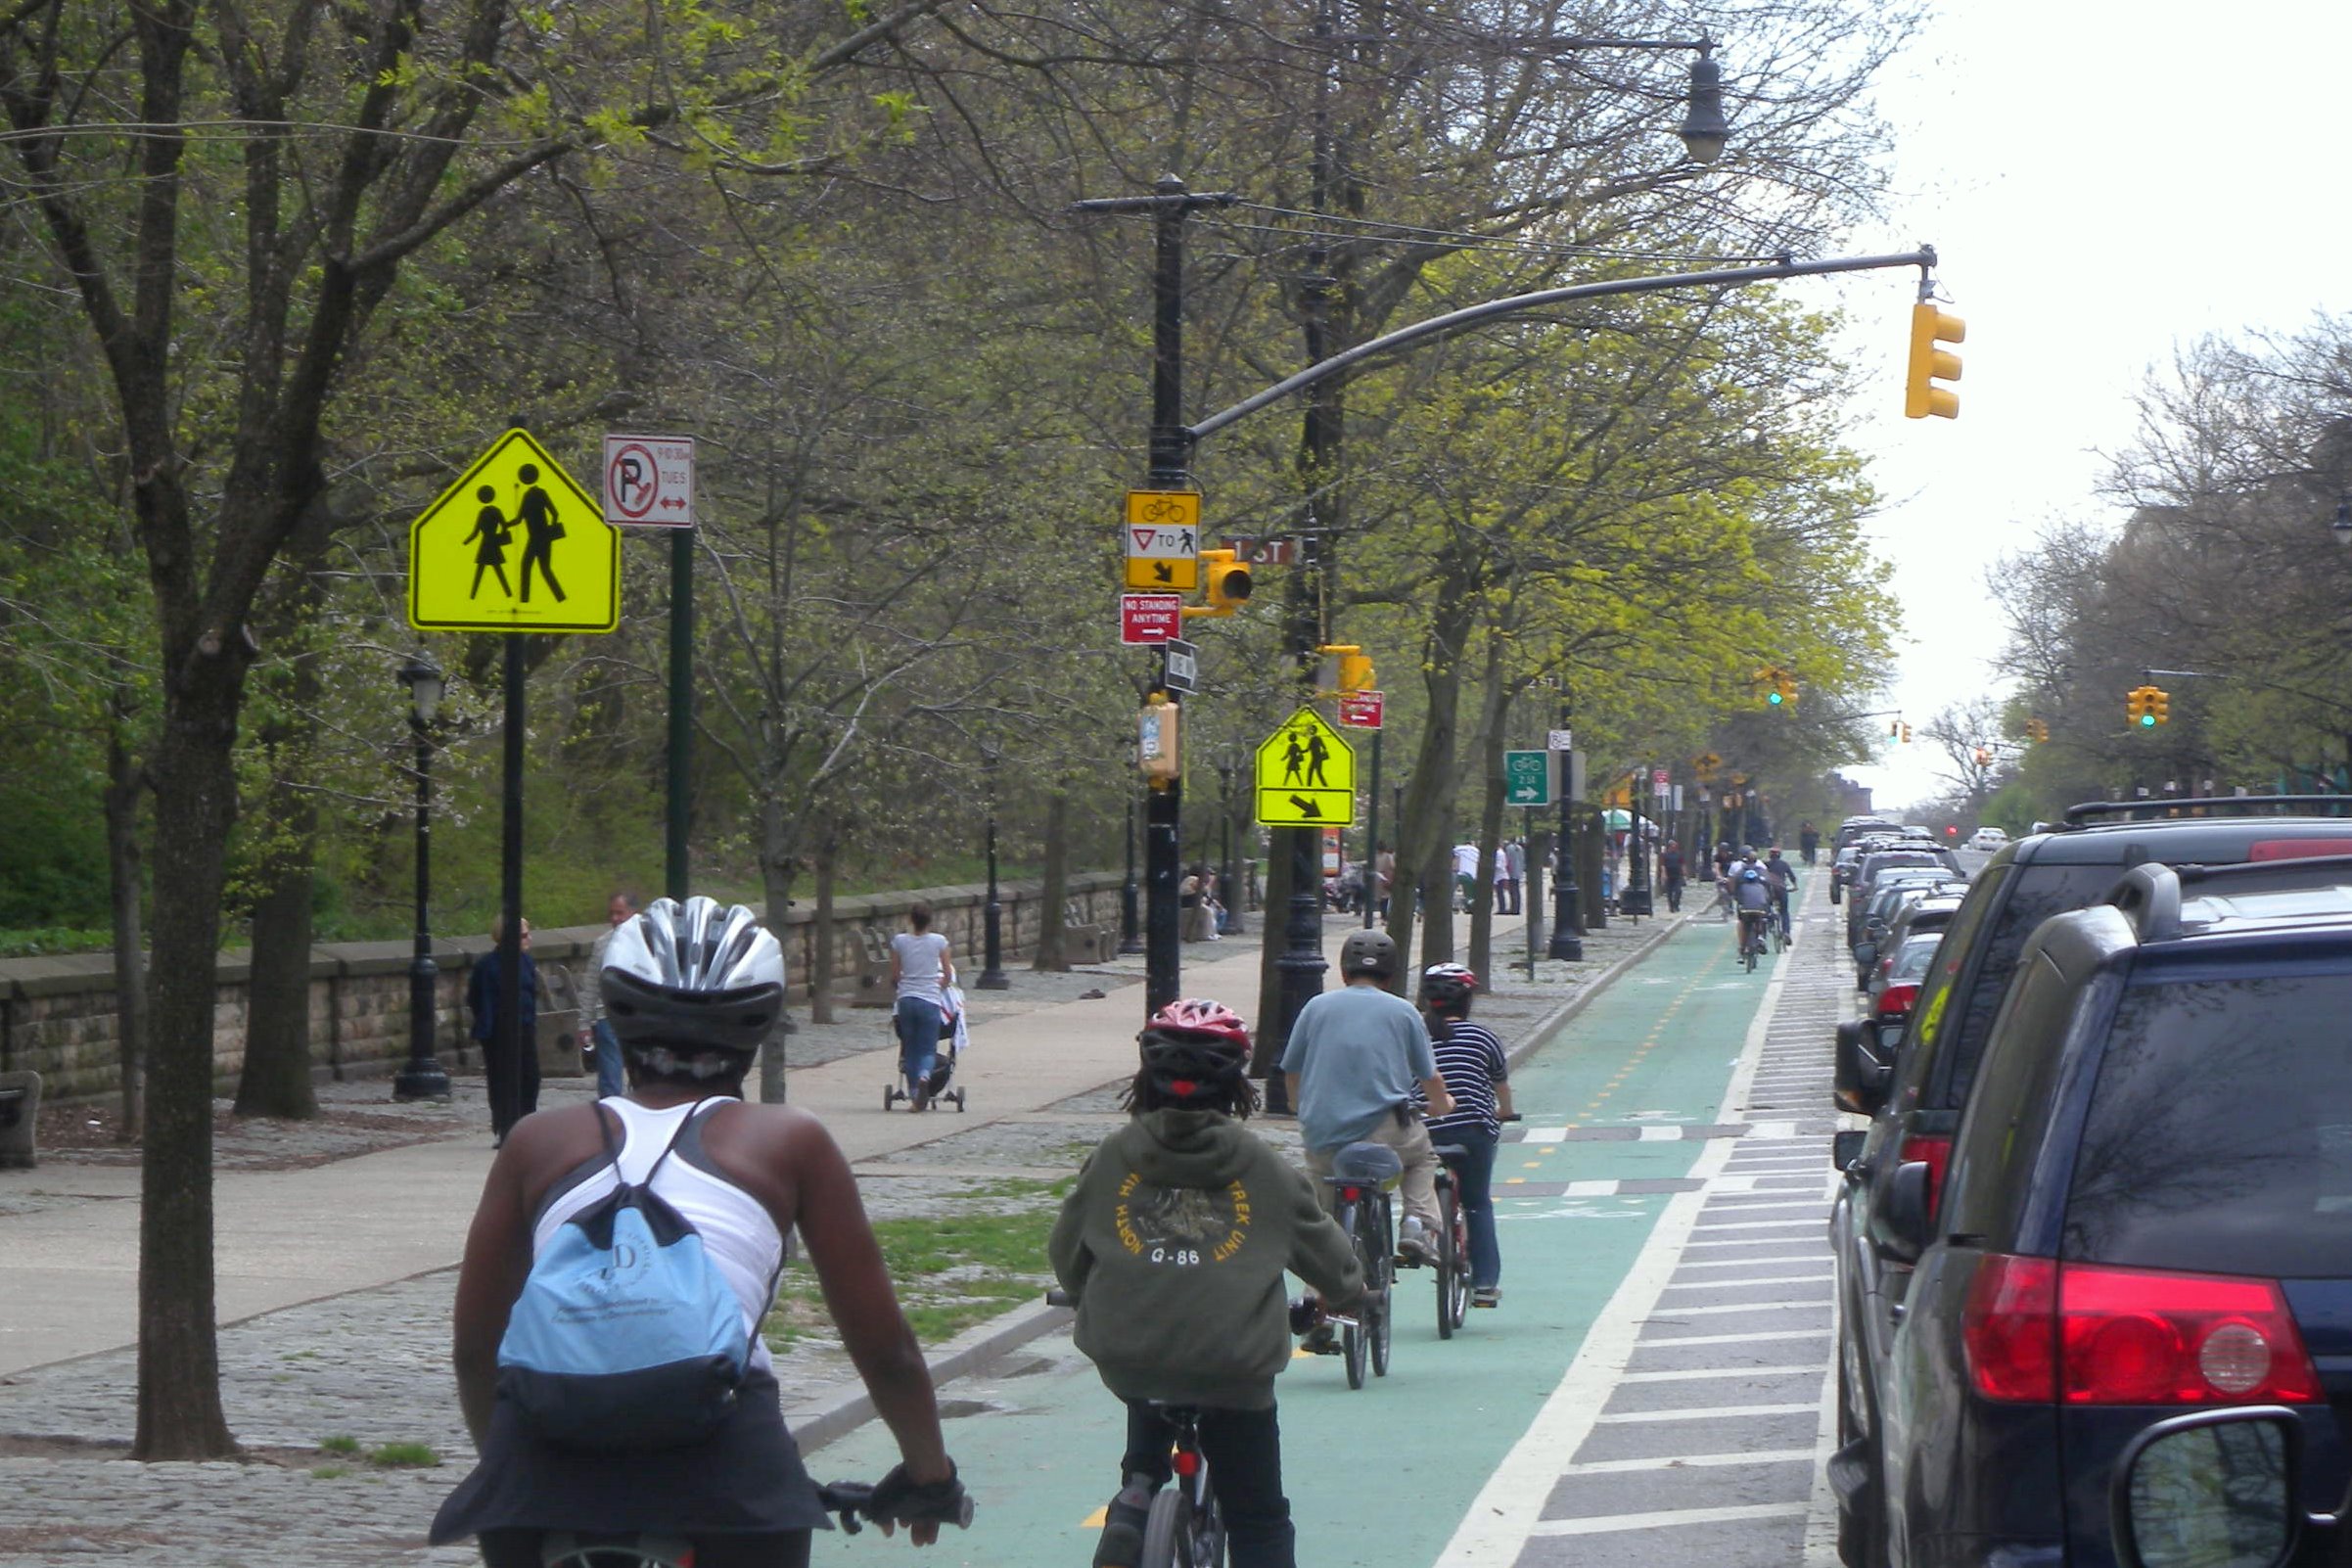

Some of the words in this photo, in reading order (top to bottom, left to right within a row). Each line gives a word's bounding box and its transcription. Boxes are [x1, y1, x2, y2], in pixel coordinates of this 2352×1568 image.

[1158, 534, 1175, 547] TO
[1125, 600, 1137, 611] NO
[1139, 600, 1177, 611] STANDING
[1131, 613, 1173, 623] ANYTIME
[1227, 1179, 1252, 1226] TREK
[1115, 1204, 1144, 1255] NORTH
[1213, 1229, 1246, 1262] UNIT
[1151, 1247, 1200, 1266] G-86
